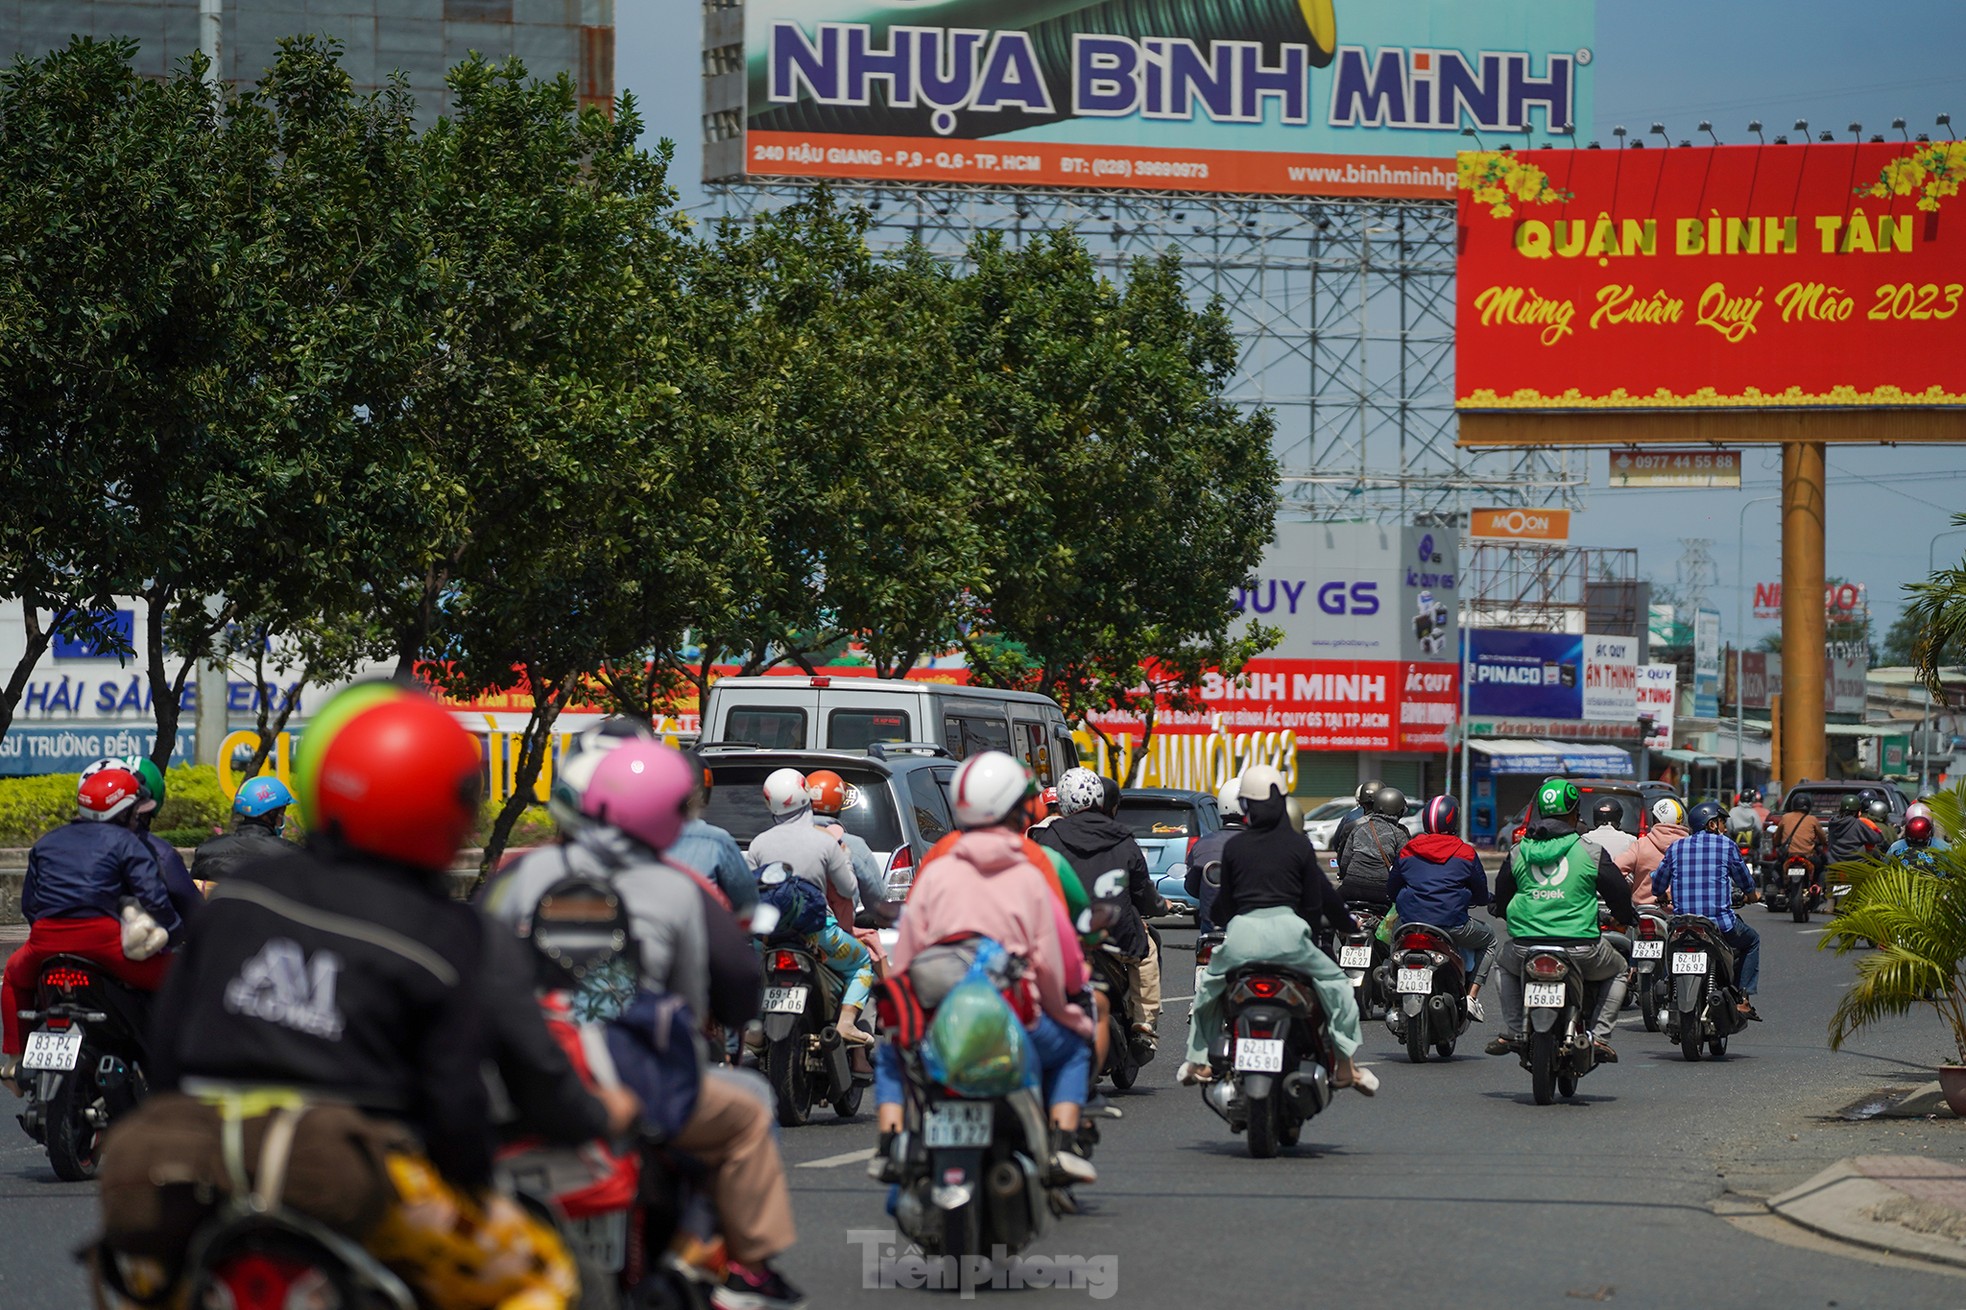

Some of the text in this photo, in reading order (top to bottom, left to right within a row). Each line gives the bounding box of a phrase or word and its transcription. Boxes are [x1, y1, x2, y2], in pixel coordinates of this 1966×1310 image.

[768, 20, 1056, 135] NHỰA
[754, 145, 785, 161] 240
[787, 142, 824, 164] HẬU
[827, 148, 882, 165] GIANG
[1516, 207, 1914, 267] QUẬN BÌNH TÂN
[1474, 282, 1964, 347] Mừng Xuân Quý Mão 2023
[1635, 456, 1669, 468] 0977
[1673, 456, 1690, 468] 44
[1716, 456, 1733, 468] 88
[1491, 511, 1549, 534] MOON
[1317, 581, 1380, 615] GS
[1478, 664, 1541, 685] PINACO
[1647, 669, 1673, 680] QUY
[24, 674, 85, 712] HẢI
[1292, 673, 1386, 702] MINH
[27, 731, 100, 757] TRƯỜNG
[104, 729, 141, 757] ĐẾN
[1532, 888, 1565, 900] gojek
[1674, 963, 1705, 973] 126.92
[34, 1035, 71, 1052] 83-P4
[27, 1051, 73, 1069] 298.56
